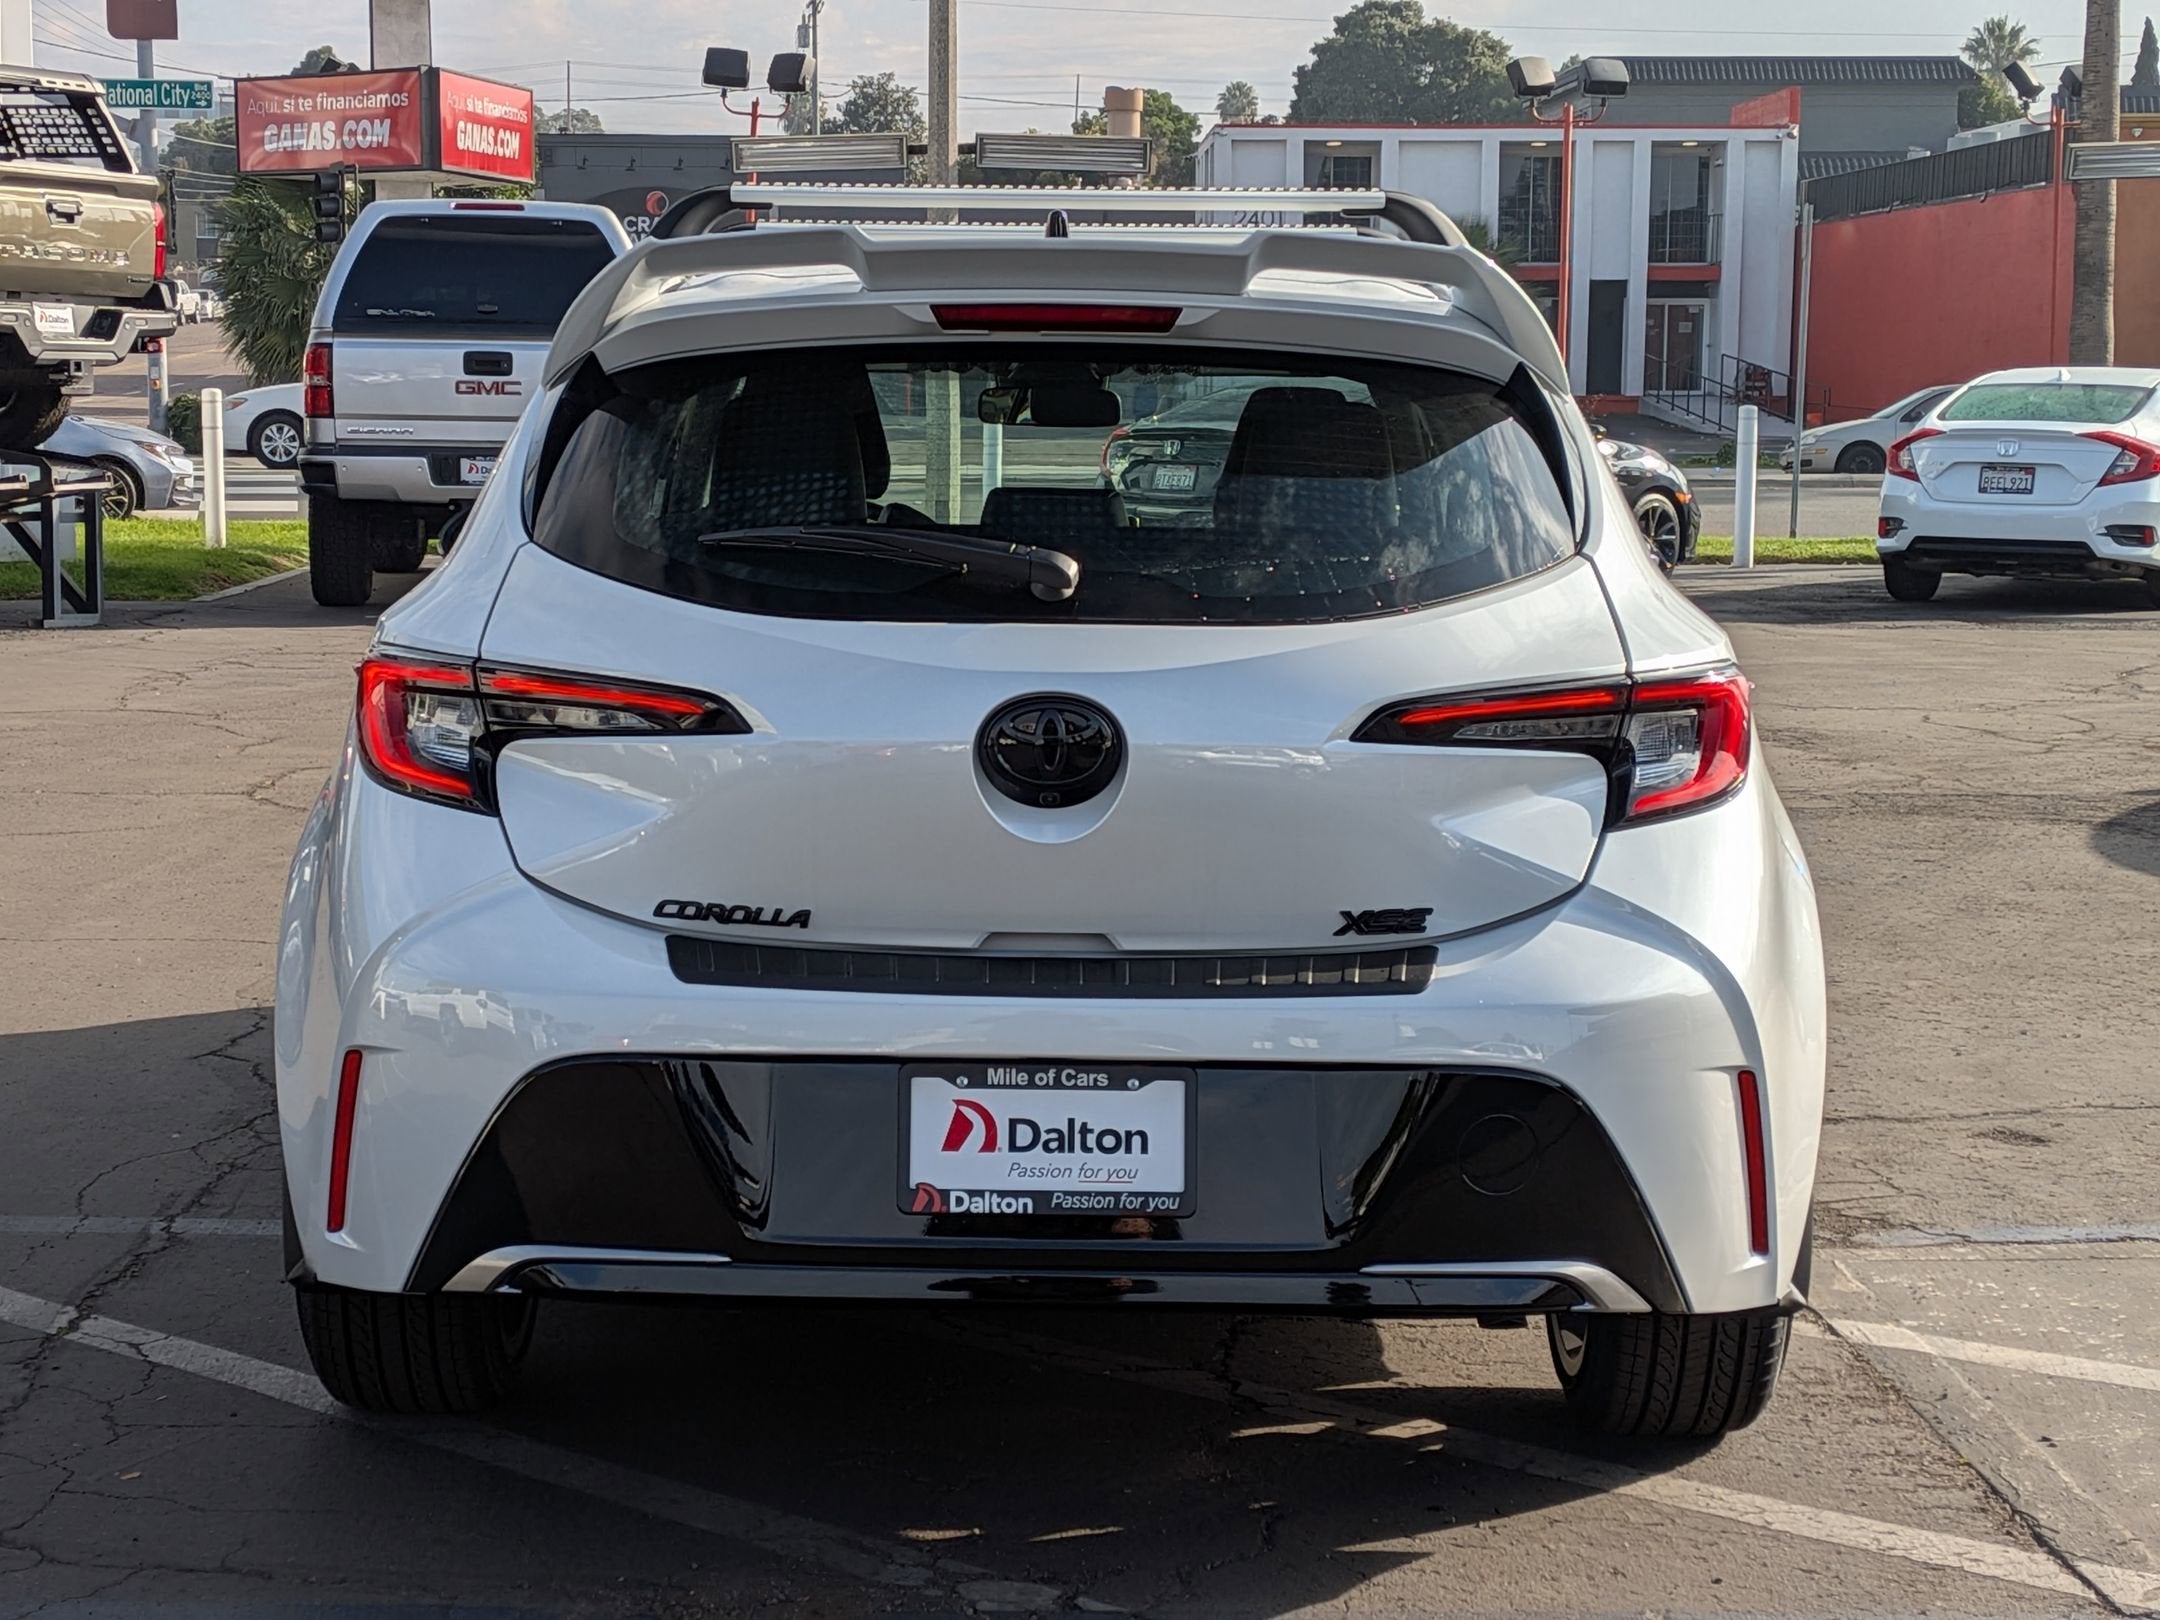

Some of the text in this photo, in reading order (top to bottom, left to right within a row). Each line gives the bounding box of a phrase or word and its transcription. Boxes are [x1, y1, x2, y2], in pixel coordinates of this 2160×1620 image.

[104, 82, 158, 105] ational
[161, 83, 190, 107] City
[283, 95, 295, 113] sí
[298, 95, 313, 112] te
[316, 89, 409, 112] financiamos
[263, 118, 391, 153] GANAS.COM
[456, 120, 520, 159] GANAS.COM
[1234, 210, 1282, 226] 2401
[455, 380, 522, 396] GMC
[652, 899, 812, 929] COROLLA
[1332, 907, 1434, 936] XSE
[987, 1068, 1109, 1087] Mile of Cars
[1008, 1117, 1149, 1155] Dalton
[1007, 1162, 1139, 1181] Passion for you
[950, 1191, 1180, 1214] Dalton Passion for you
